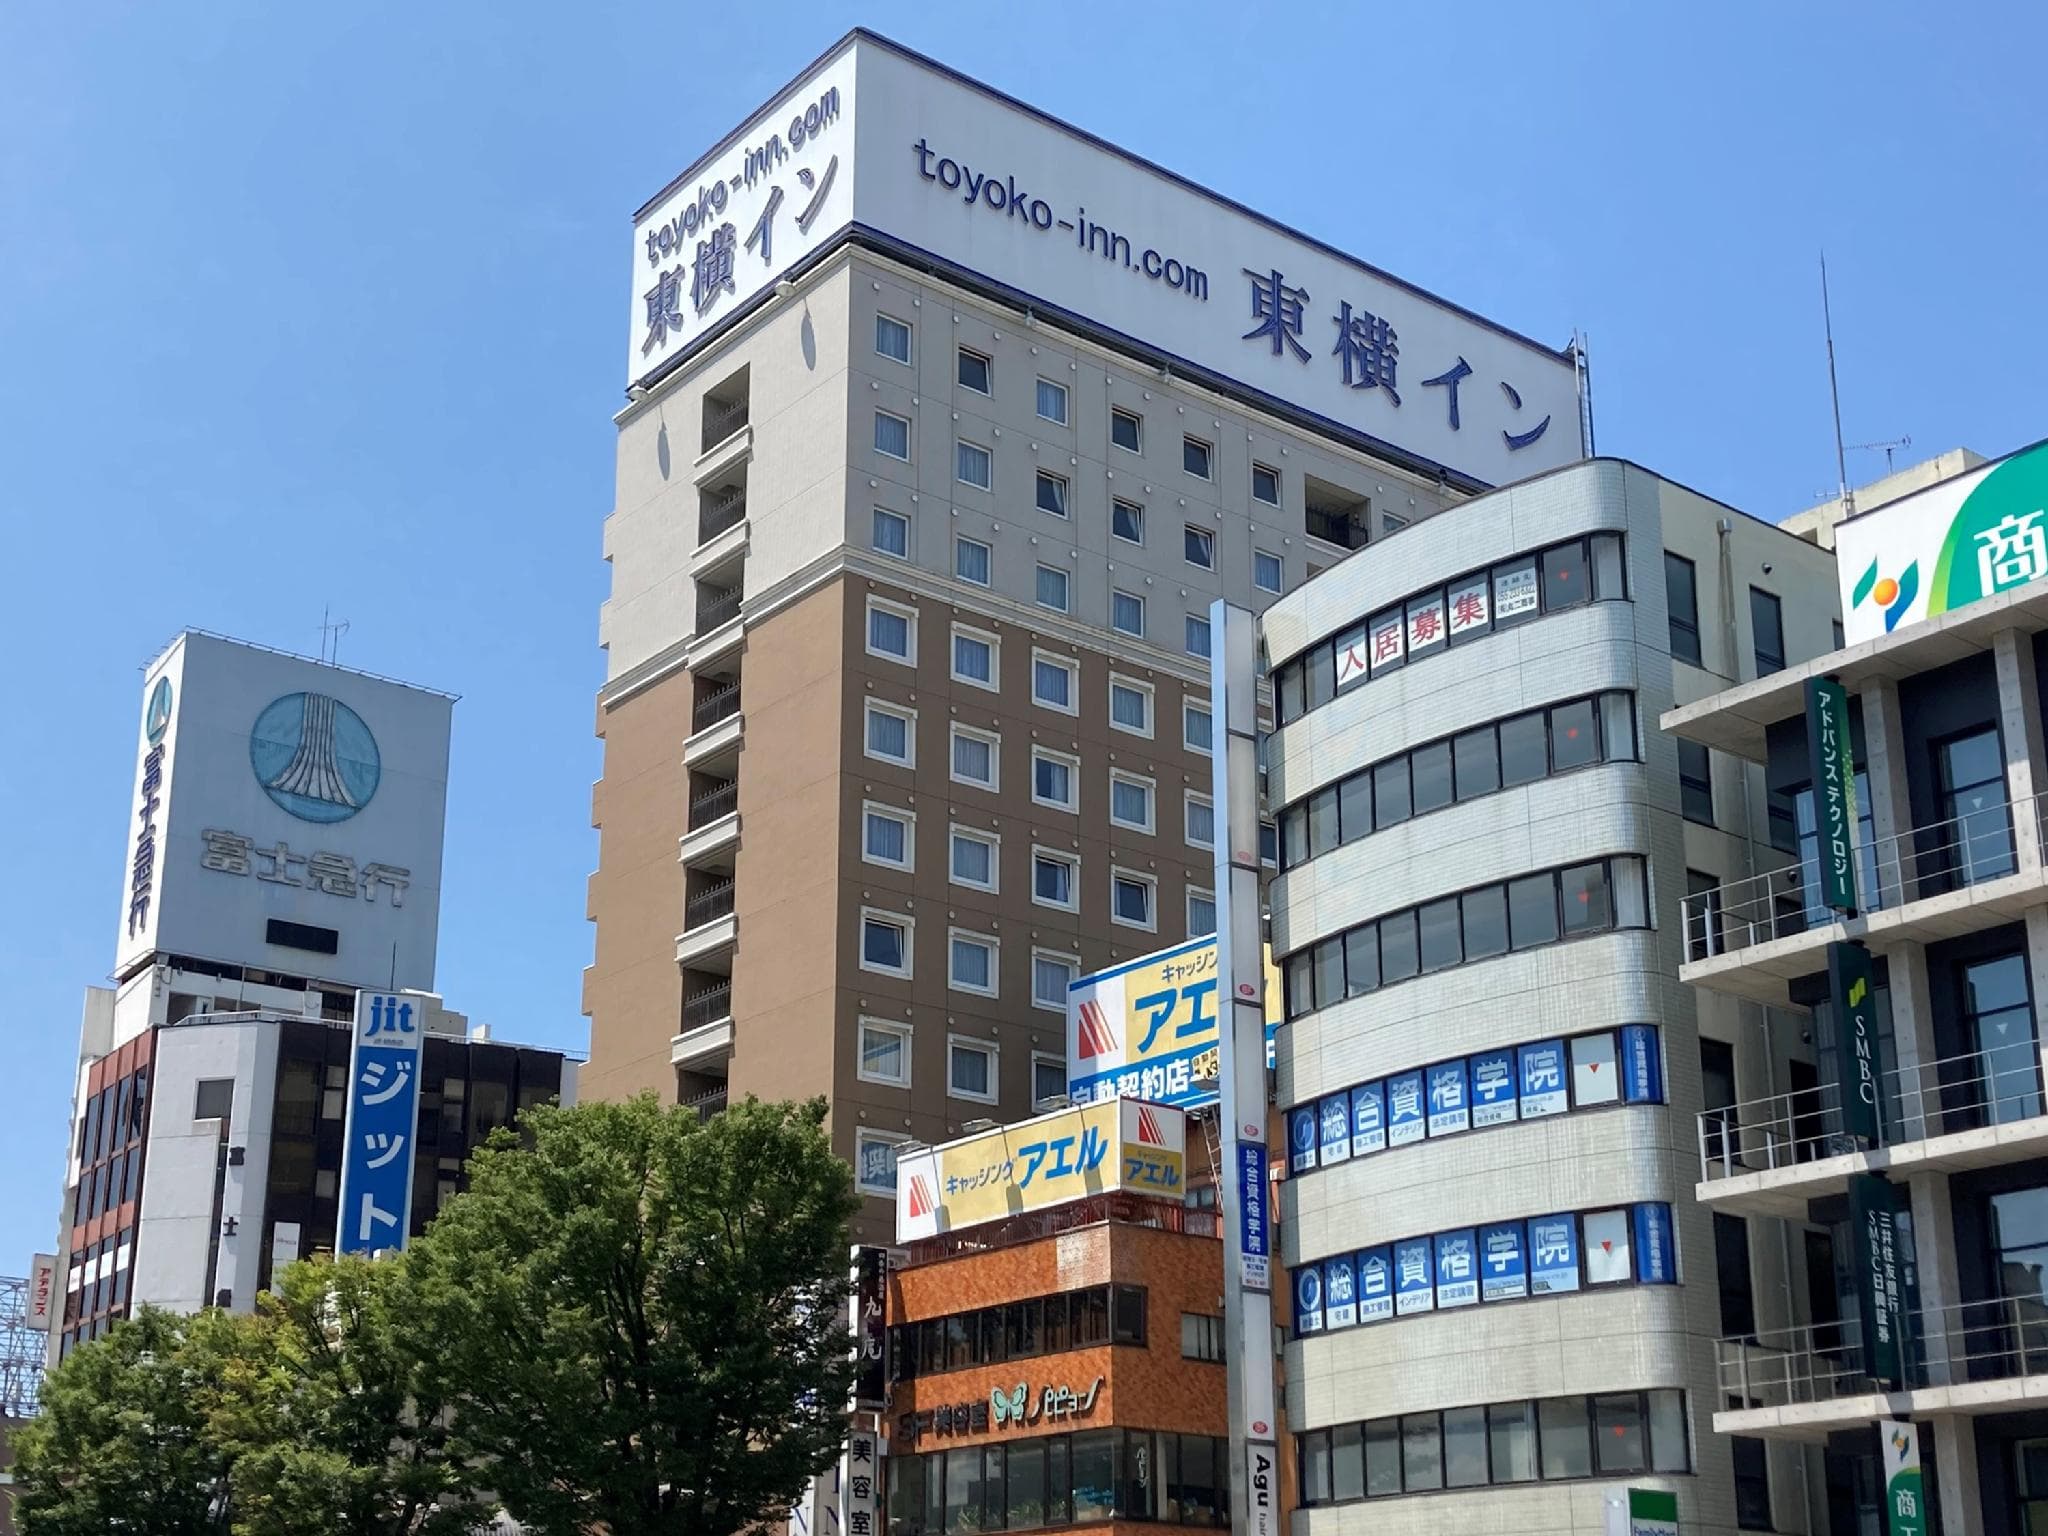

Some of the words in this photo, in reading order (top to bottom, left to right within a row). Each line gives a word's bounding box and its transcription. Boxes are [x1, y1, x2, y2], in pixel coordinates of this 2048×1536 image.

[644, 86, 840, 268] toyoko-inn.com
[914, 138, 1208, 301] toyoko-inn.com
[642, 154, 839, 358] 東横イン
[1242, 269, 1551, 452] 東横イン
[1973, 509, 2048, 597] 商
[1340, 592, 1485, 681] 入居募集
[1817, 691, 1850, 896] アドバンステクノロジー
[127, 743, 165, 940] 富士急行
[201, 828, 410, 908] 富士急行
[1162, 950, 1217, 983] キャッシン
[365, 997, 414, 1037] jit
[1135, 978, 1218, 1054] アエ
[1855, 1015, 1873, 1104] SMBC
[1072, 1058, 1189, 1104] 自動契約店
[1322, 1050, 1559, 1142] 総合資格学院
[361, 1061, 410, 1240] ジット
[946, 1158, 1017, 1195] キャッシング
[1018, 1126, 1108, 1189] アエル
[1125, 1158, 1180, 1187] アエル
[1330, 1223, 1569, 1303] 総合資格学院
[851, 1438, 872, 1536] 美容室
[1254, 1453, 1271, 1507] Agu
